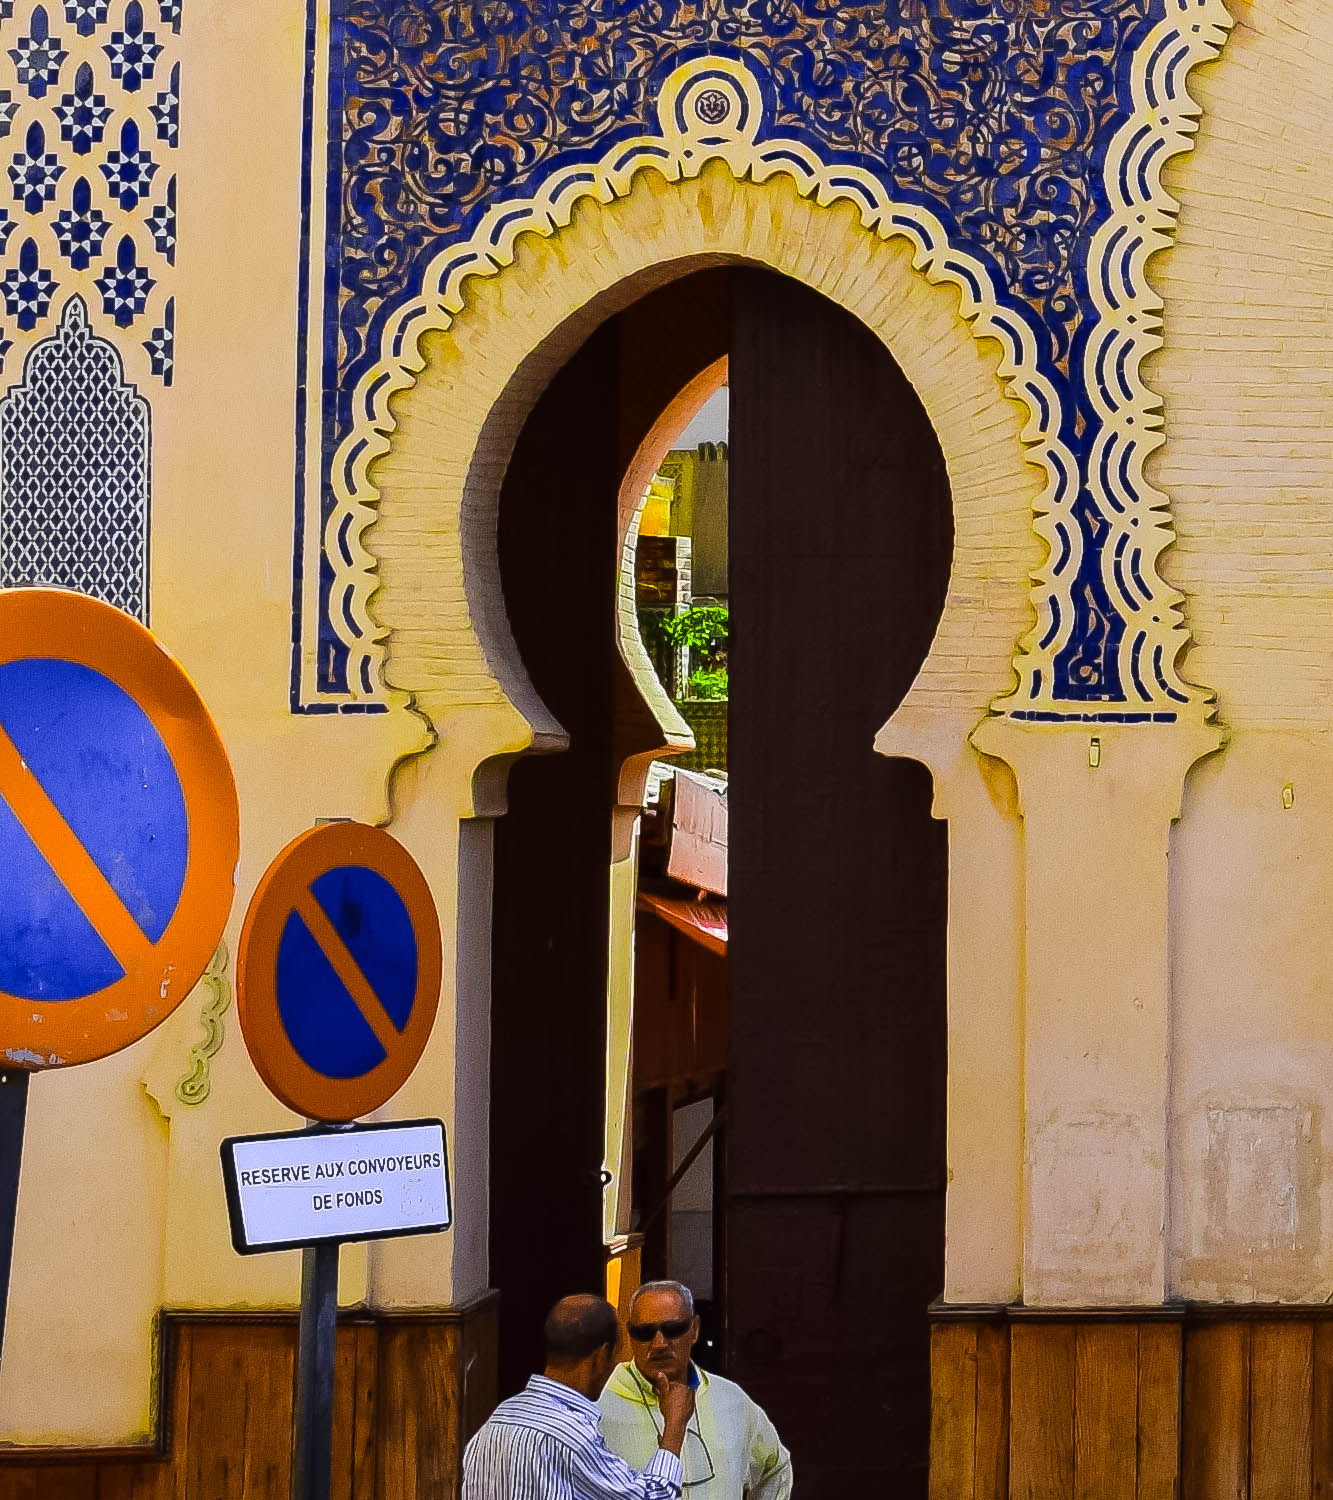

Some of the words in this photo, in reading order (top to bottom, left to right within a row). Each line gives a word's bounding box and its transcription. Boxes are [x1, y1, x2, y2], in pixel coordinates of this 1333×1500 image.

[241, 1165, 310, 1186] RESERVE
[315, 1162, 344, 1180] AUX
[348, 1153, 441, 1176] CONVOYEURS
[313, 1194, 333, 1211] DE
[336, 1189, 383, 1209] FONDS
